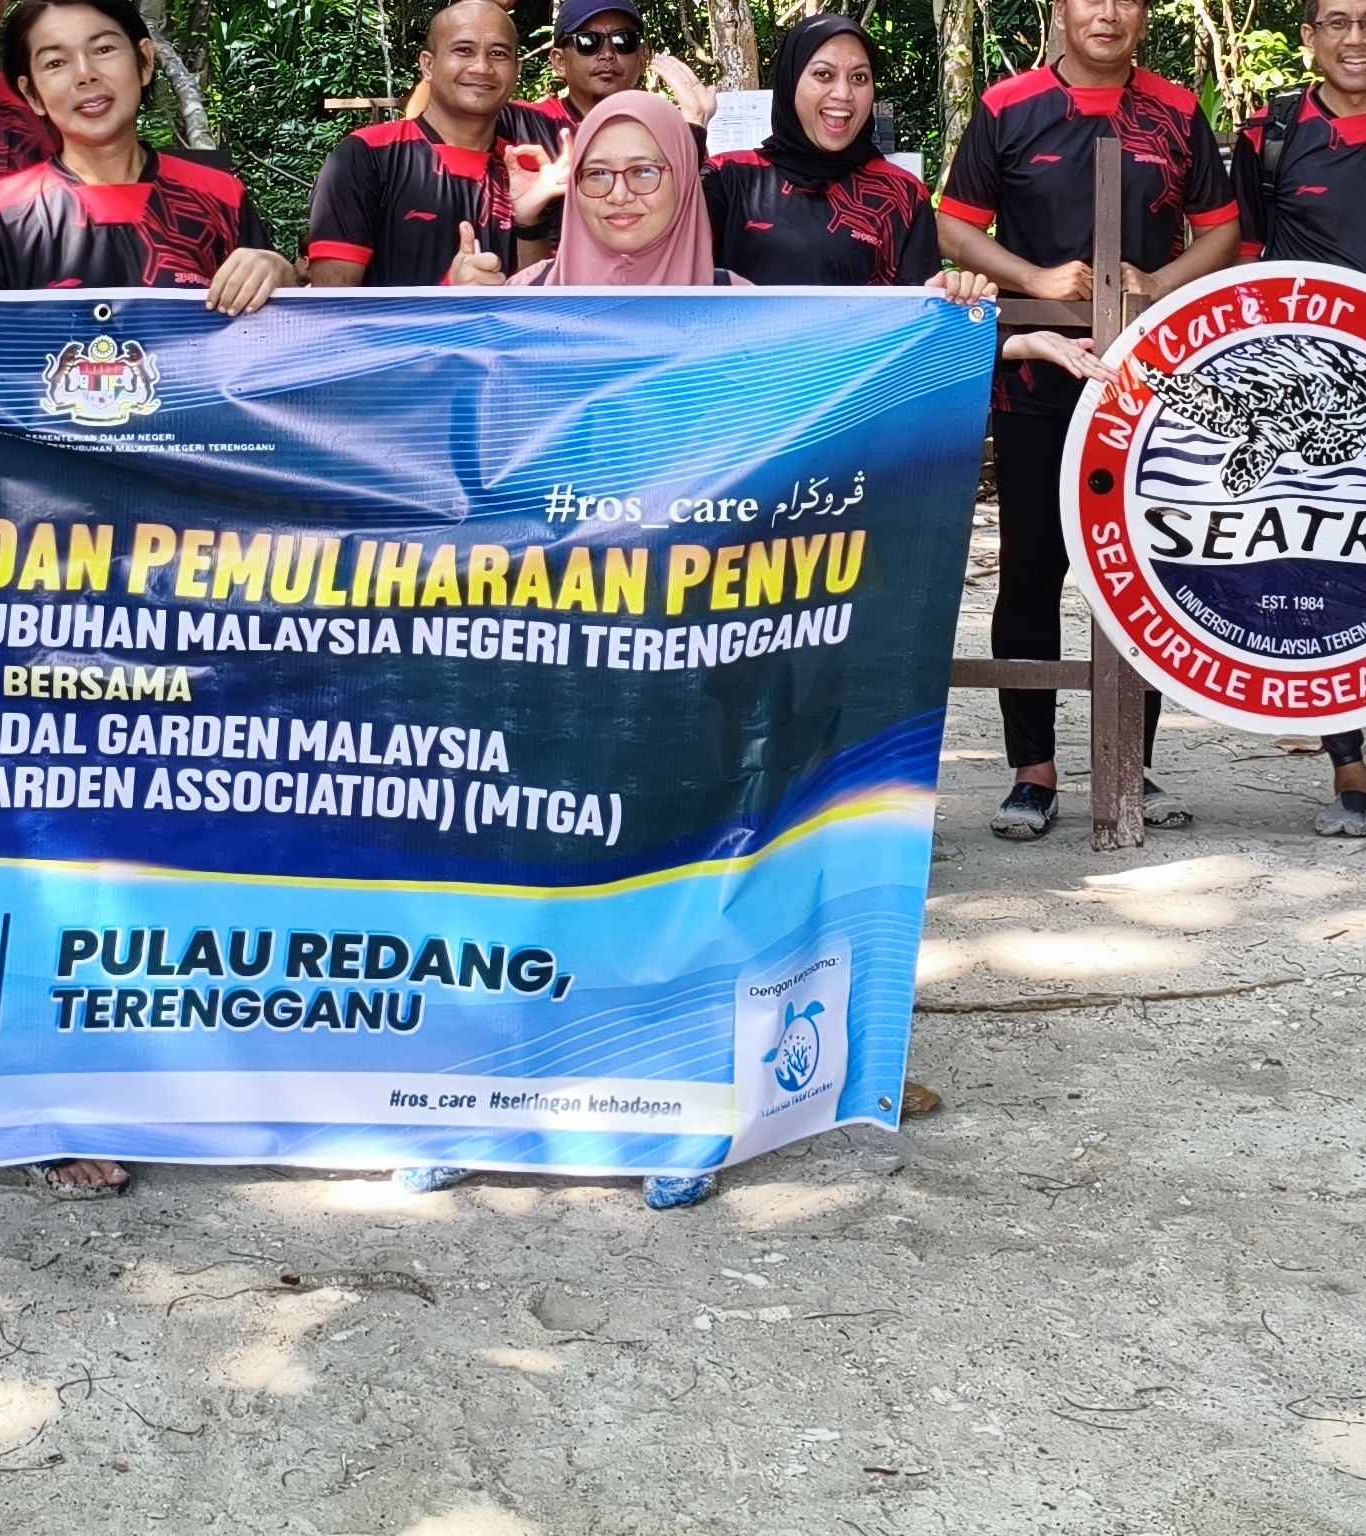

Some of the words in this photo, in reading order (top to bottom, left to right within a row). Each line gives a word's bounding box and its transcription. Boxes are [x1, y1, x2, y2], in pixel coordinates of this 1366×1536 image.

[1097, 388, 1146, 452] We
[1157, 296, 1264, 364] Care
[1278, 276, 1356, 325] for
[100, 432, 136, 443] DALAM
[138, 432, 176, 442] NEGERI
[115, 443, 166, 453] MALAYSIA
[166, 443, 205, 452] NEGERI
[208, 442, 276, 452] TERENGGANU
[544, 483, 759, 530] #ros_care
[128, 520, 648, 616] PEMULIHARAAN
[665, 529, 867, 616] PENYU
[1090, 520, 1135, 598] SEA
[1126, 595, 1253, 702] TURTLE
[1175, 584, 1246, 644] UNIVERSITI
[1246, 631, 1323, 656] MALAYSIA
[1261, 594, 1289, 610] EST.
[1292, 595, 1325, 611] 1984
[176, 611, 397, 655] MALAYSIA
[412, 615, 572, 666] NEGERI
[582, 602, 853, 672] TERENGGANU
[2, 664, 193, 703] BERSAMA
[97, 713, 280, 762] GARDEN
[287, 721, 510, 774] MALAYSIA
[143, 767, 456, 832] ASSOCIATION)
[464, 780, 624, 848] (MTGA)
[55, 927, 275, 984] PULAU
[284, 931, 576, 1005] REDANG,
[748, 978, 794, 999] Dengan
[48, 986, 427, 1036] TERENGGANU
[389, 1089, 477, 1110] #ros_care
[587, 1094, 683, 1119] kehadapan
